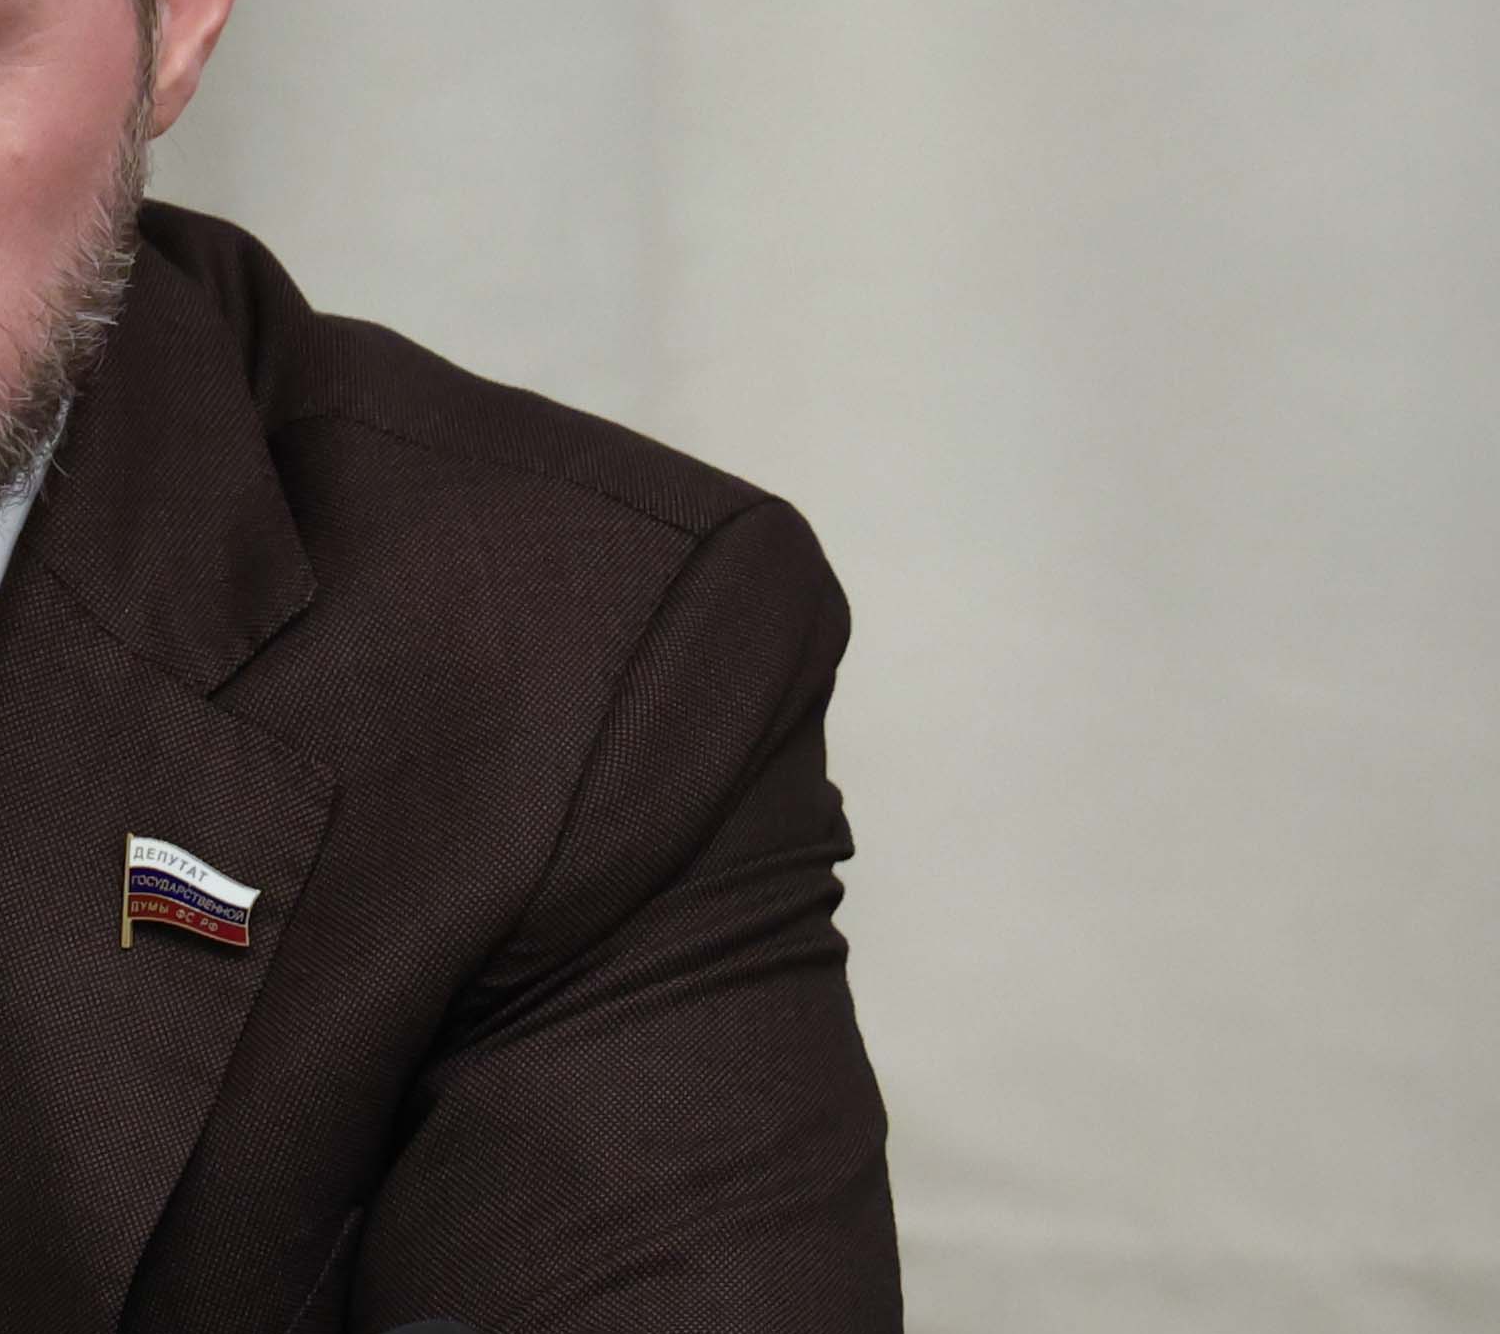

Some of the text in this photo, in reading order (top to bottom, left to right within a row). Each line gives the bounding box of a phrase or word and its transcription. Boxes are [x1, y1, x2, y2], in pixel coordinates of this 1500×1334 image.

[133, 846, 210, 882] ДЕПУТАТ
[131, 875, 245, 922] ГОСУДАРСТВЕННОЙ
[131, 900, 219, 932] ДУМЫ ФС РФ
